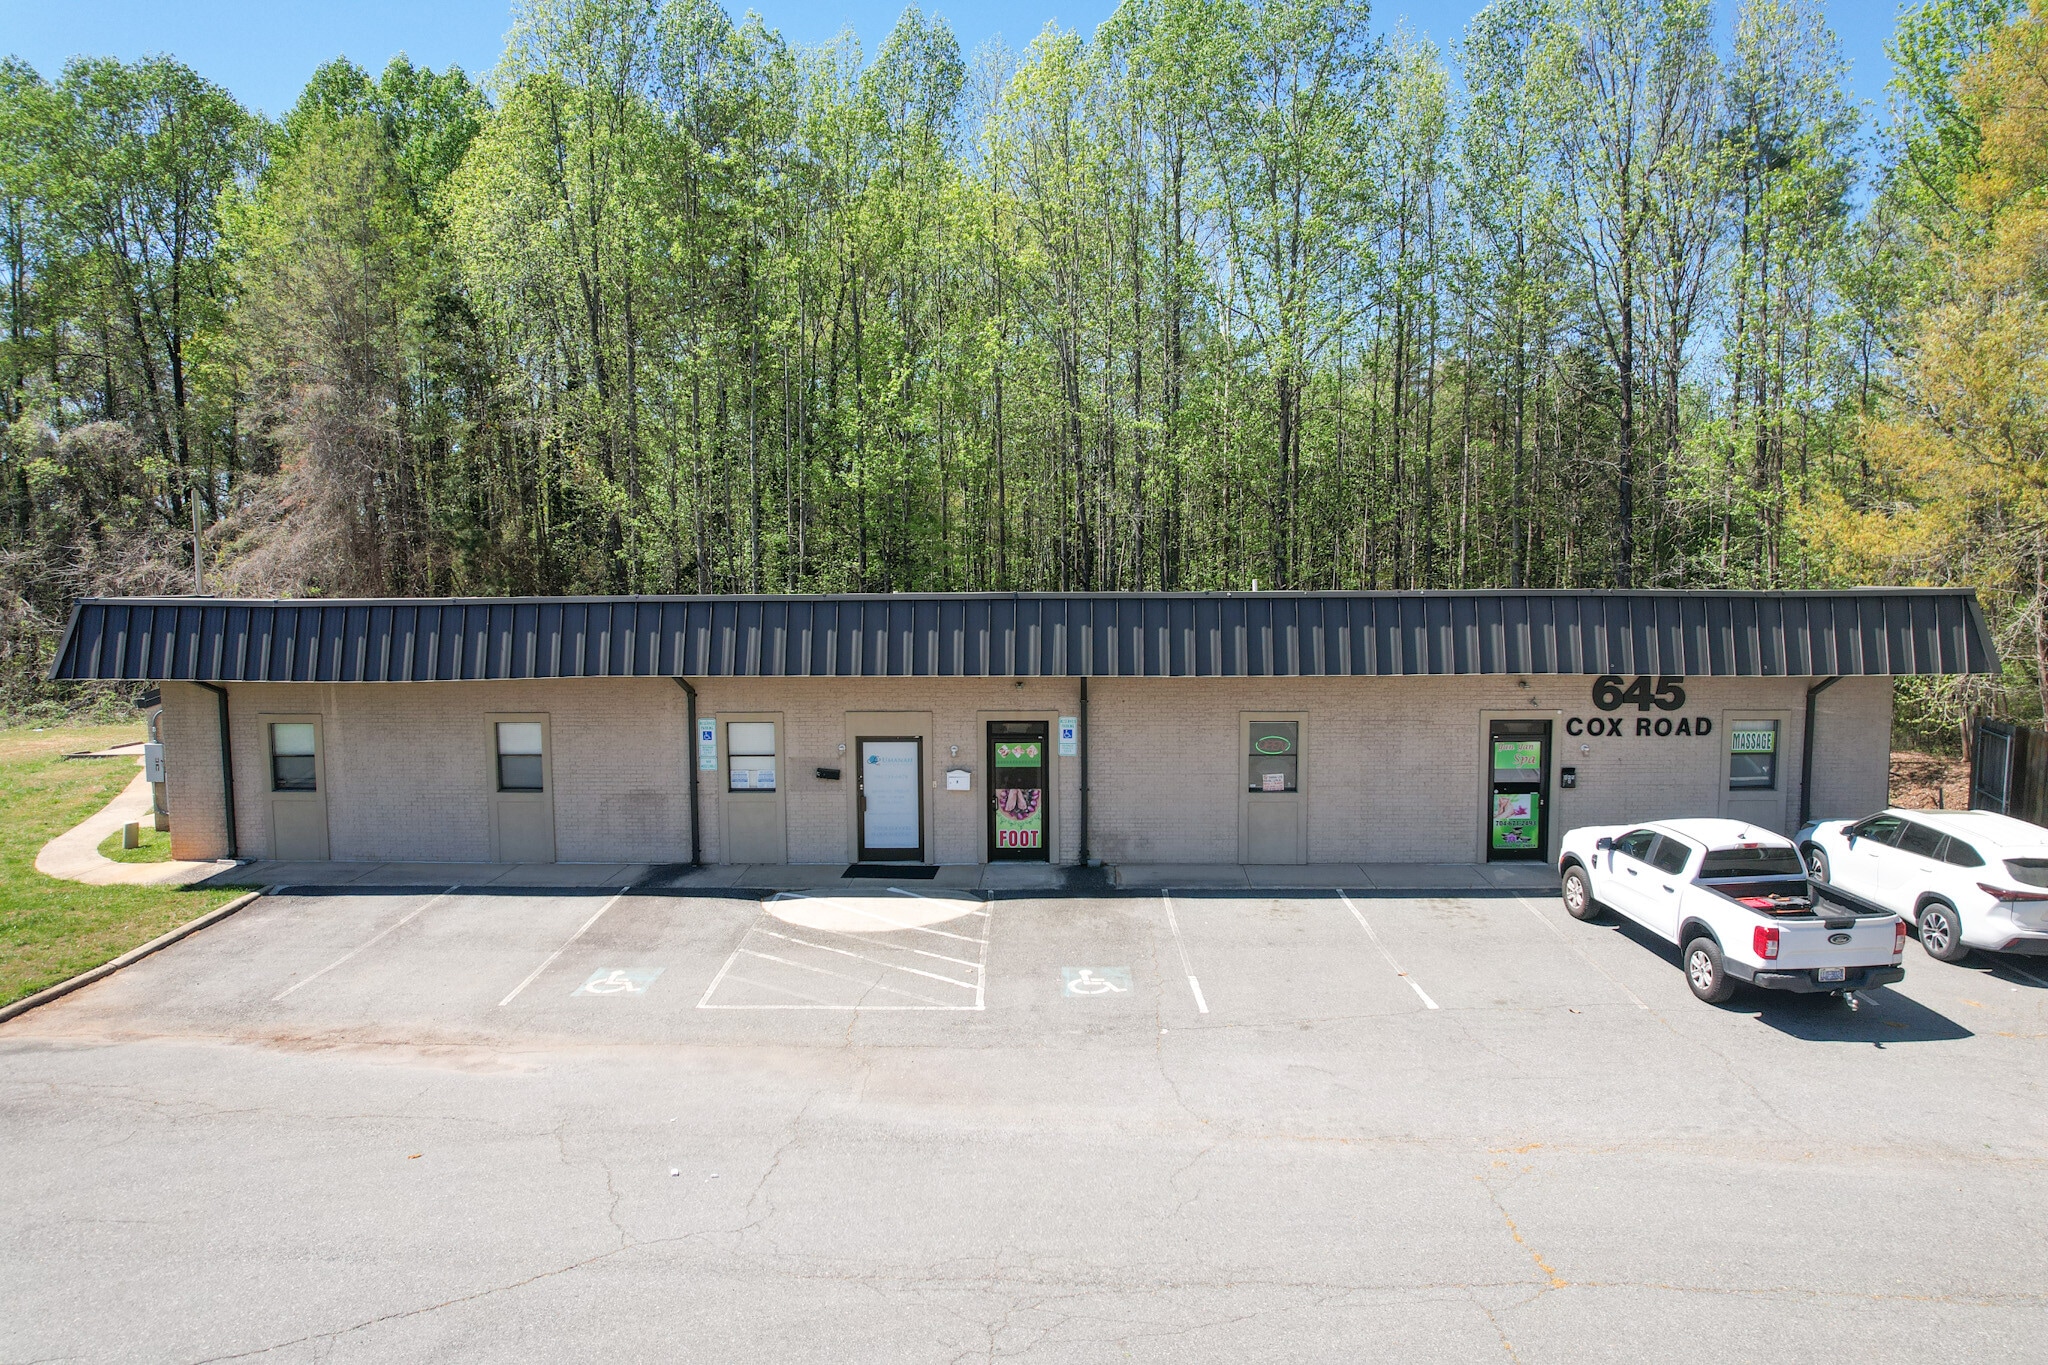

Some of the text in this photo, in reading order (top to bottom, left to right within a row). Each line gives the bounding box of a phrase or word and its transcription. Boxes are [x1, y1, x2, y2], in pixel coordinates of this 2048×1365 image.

[1592, 675, 1686, 712] 645
[1566, 717, 1712, 737] COX ROAD
[1732, 732, 1772, 750] MASSAGE
[1513, 753, 1536, 768] Spa
[999, 830, 1039, 847] FOOT
